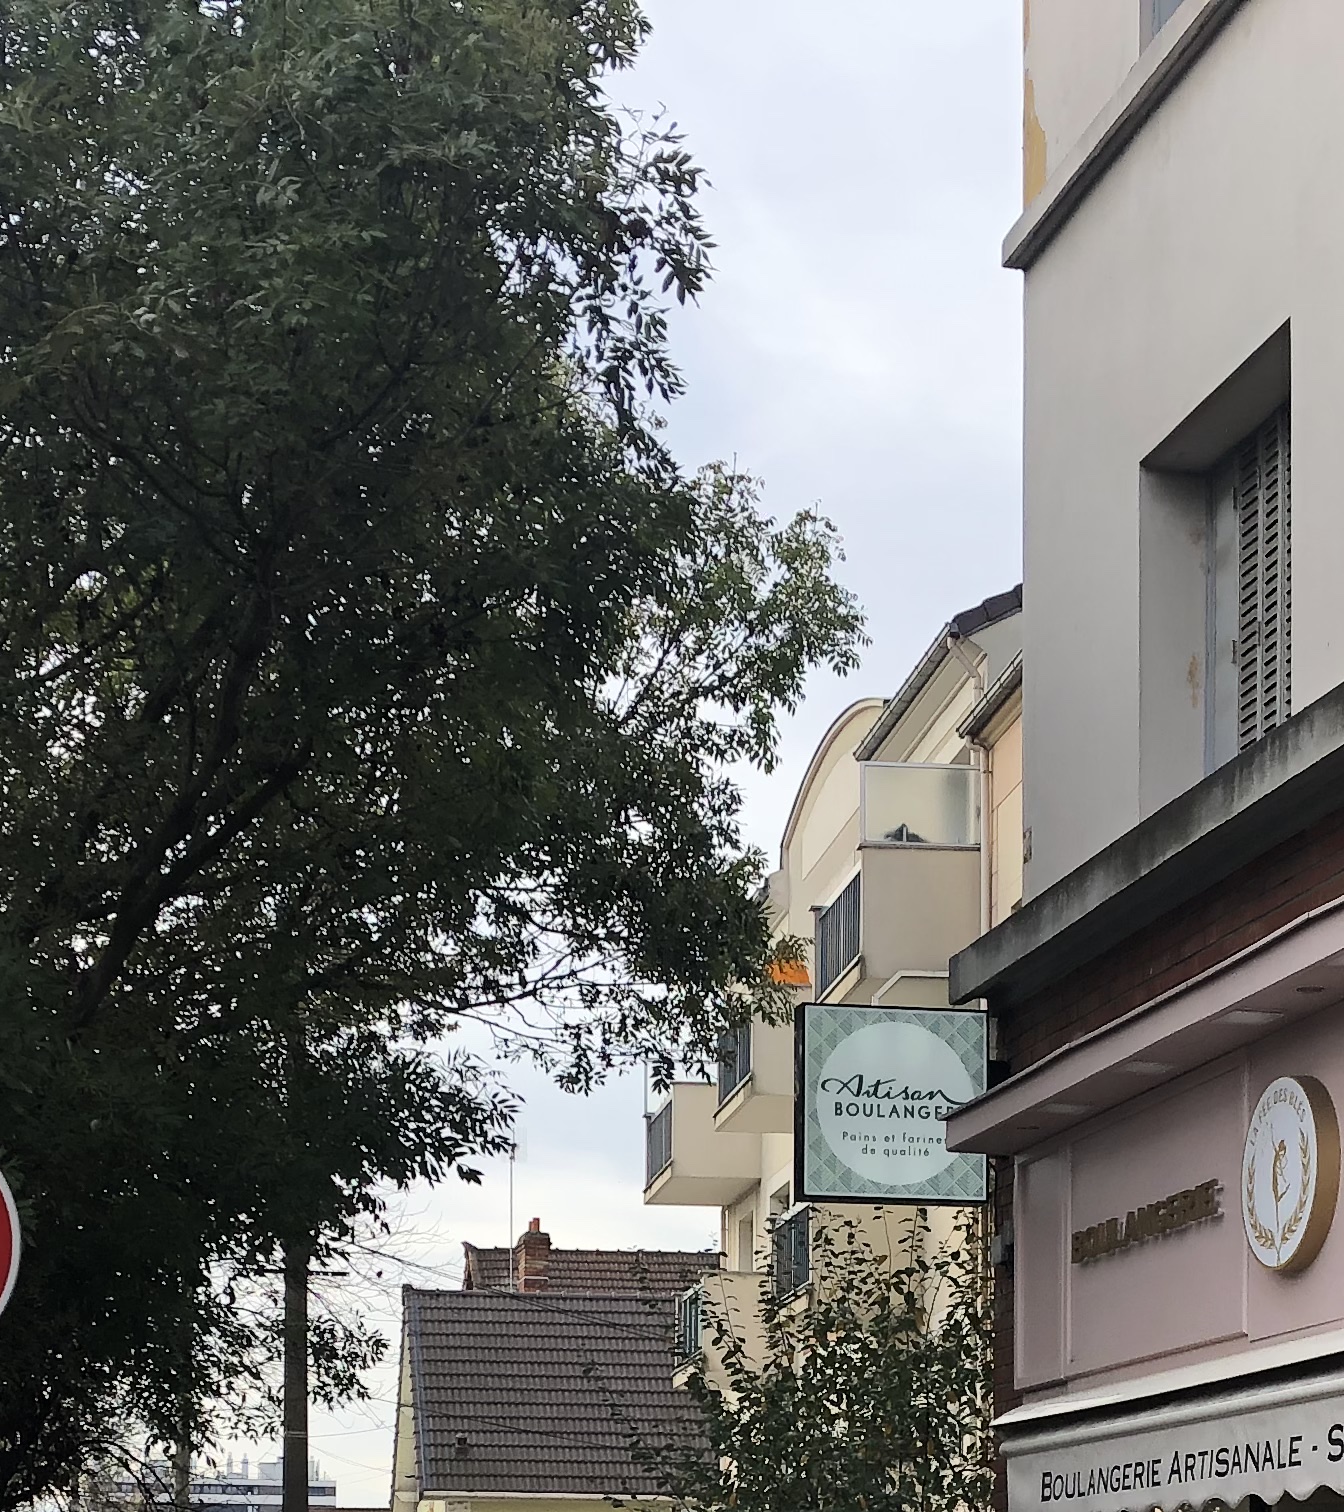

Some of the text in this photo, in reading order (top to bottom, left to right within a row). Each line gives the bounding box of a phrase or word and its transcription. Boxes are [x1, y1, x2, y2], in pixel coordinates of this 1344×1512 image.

[821, 1074, 969, 1106] Artisan
[842, 1131, 947, 1145] Pains et farine
[861, 1144, 930, 1159] de qualité
[1071, 1178, 1223, 1263] BOULANGERIE
